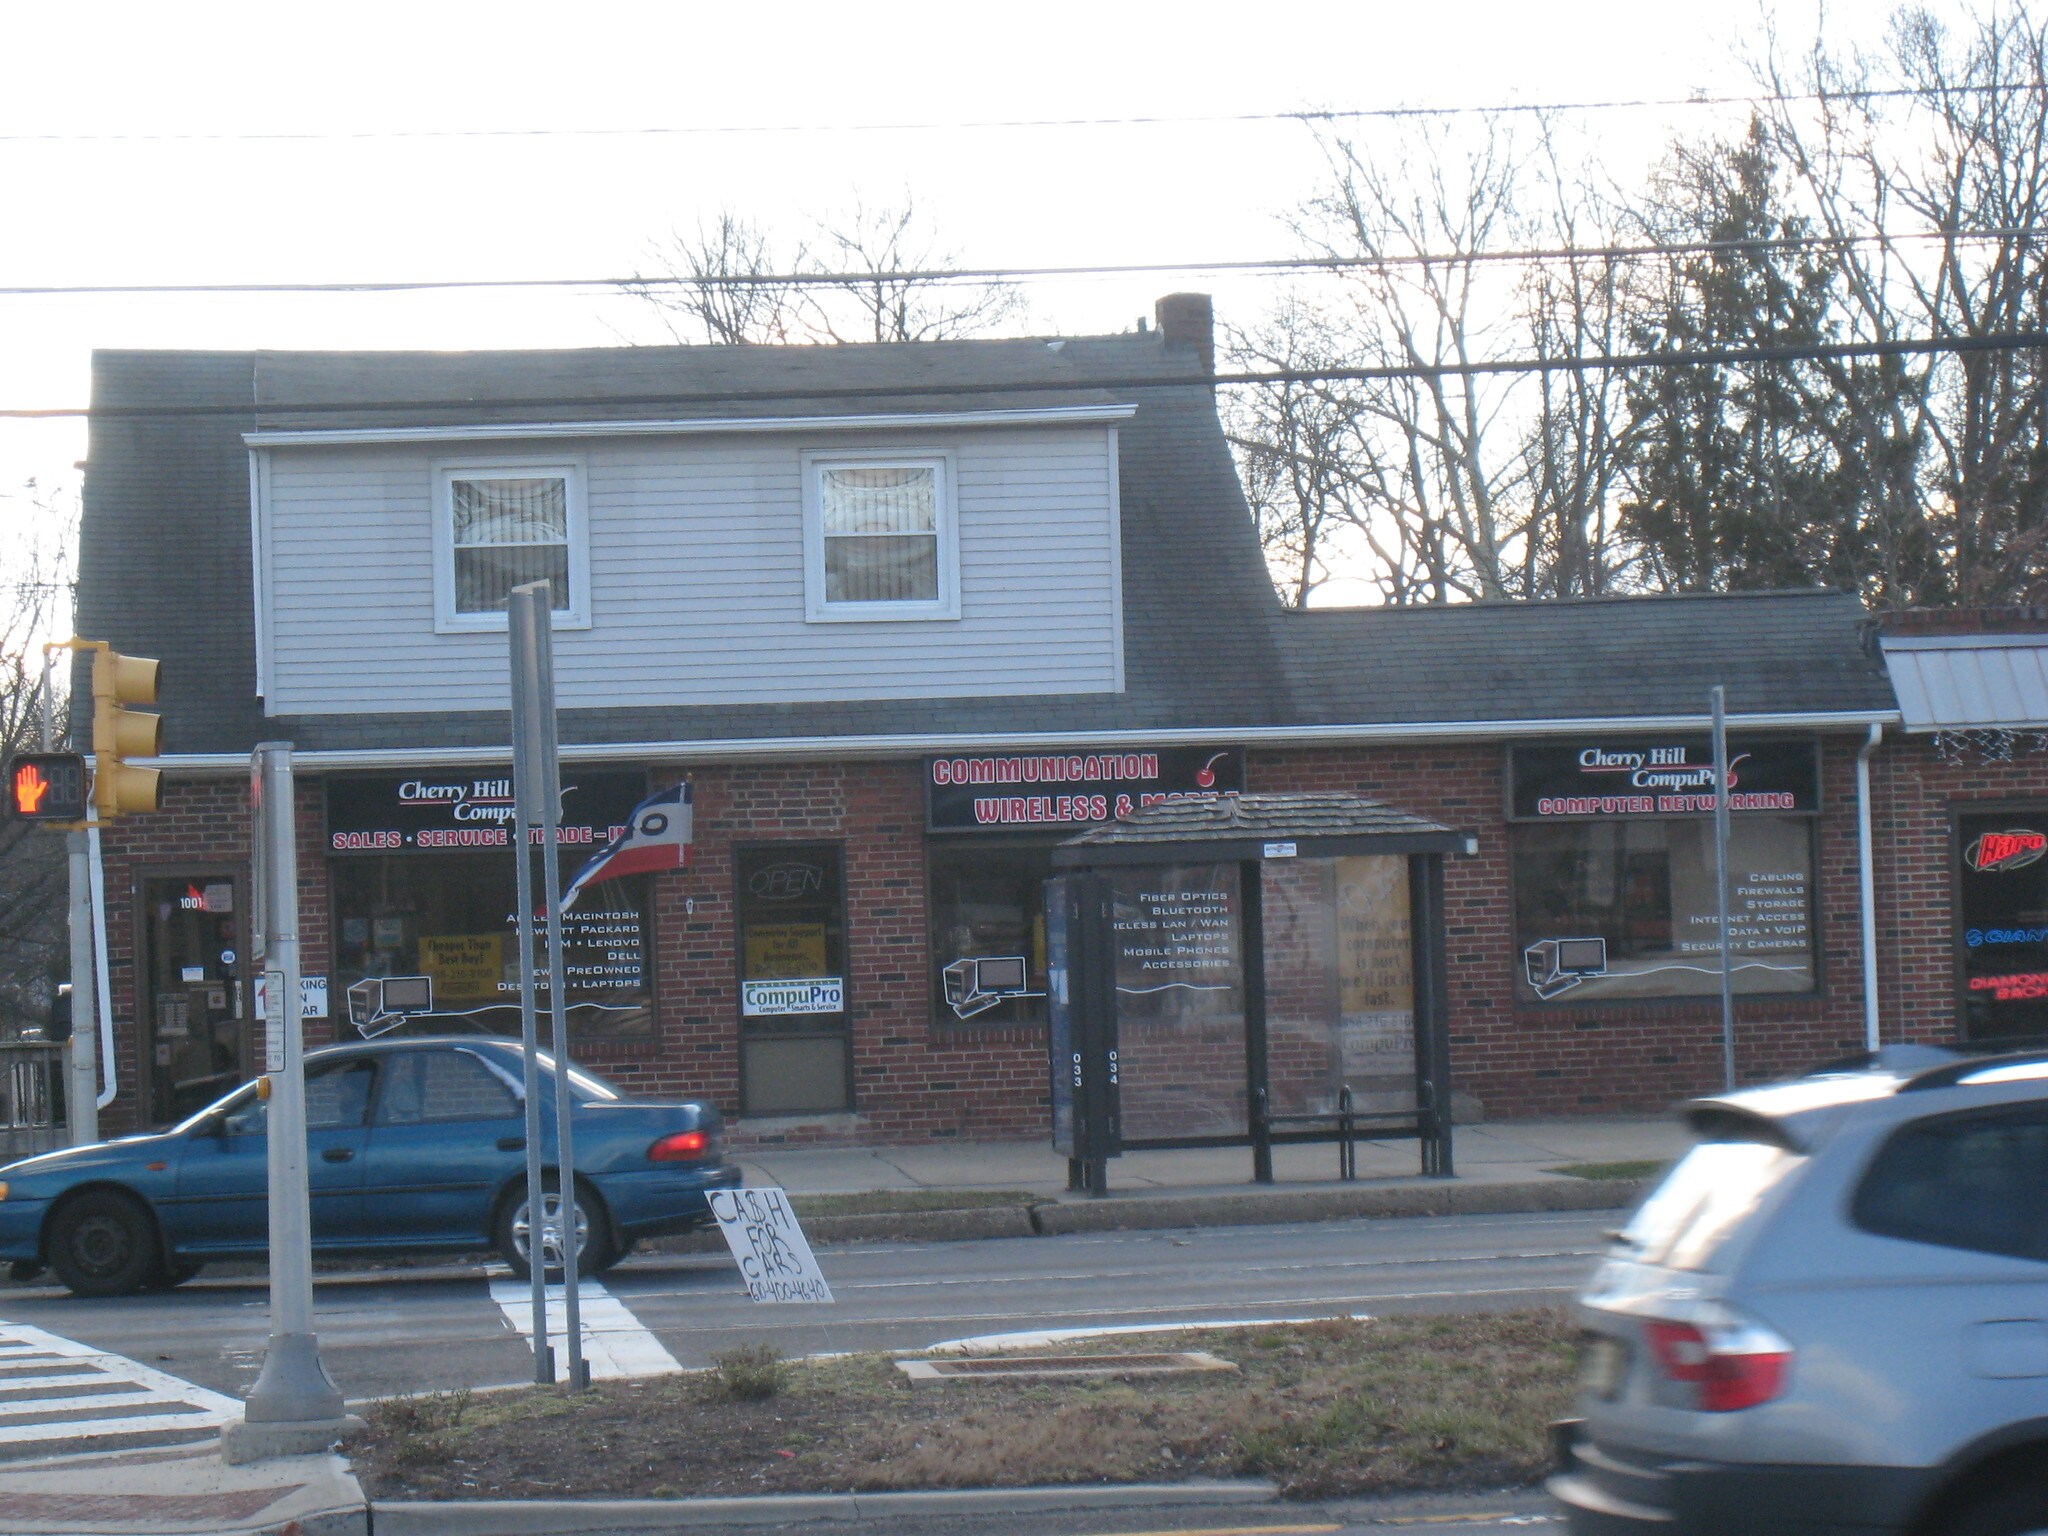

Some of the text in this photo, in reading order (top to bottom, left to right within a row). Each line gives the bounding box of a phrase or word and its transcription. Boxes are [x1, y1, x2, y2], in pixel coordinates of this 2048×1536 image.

[1579, 747, 1686, 770] Cherry Hill
[933, 754, 1158, 785] COMMUNICATION
[1632, 769, 1716, 791] CompuPr
[399, 780, 509, 803] Cherry Hill
[974, 795, 1107, 824] WIRELESS
[1115, 794, 1134, 819] &
[1538, 792, 1794, 815] COMPUTER NETWRKING
[454, 803, 516, 825] Comp
[333, 831, 401, 849] SALES
[417, 829, 508, 847] SERVICE
[749, 869, 823, 892] OPEN
[1750, 873, 1804, 882] CABLING
[1737, 887, 1804, 895] FIREWALLS
[1140, 892, 1228, 902] FIBER OPTICS
[180, 897, 202, 909] 1001
[1747, 900, 1805, 909] STORAGE
[1152, 906, 1228, 915] BLUETOOTH
[506, 912, 639, 923] ALE MACINTOSH
[1690, 913, 1805, 924] INTENET ACCESS
[1113, 921, 1157, 930] RELESS
[1200, 919, 1228, 927] WAN
[581, 926, 640, 935] PACKARD
[1728, 928, 1760, 936] DATA
[1172, 933, 1229, 941] LAPTOPS
[545, 939, 641, 948] IM LENOVO
[1681, 940, 1806, 951] SECURTY CAMERAS
[608, 952, 641, 961] DELL
[1124, 946, 1229, 957] MOBILE PHONES
[1142, 960, 1230, 970] ACCESSORIES
[534, 968, 550, 976] EW
[583, 979, 642, 988] LAPTOPS
[746, 985, 840, 1008] CompuPro
[759, 1006, 786, 1014] Computer
[746, 1222, 791, 1258] FOR
[743, 1252, 802, 1279] CARS
